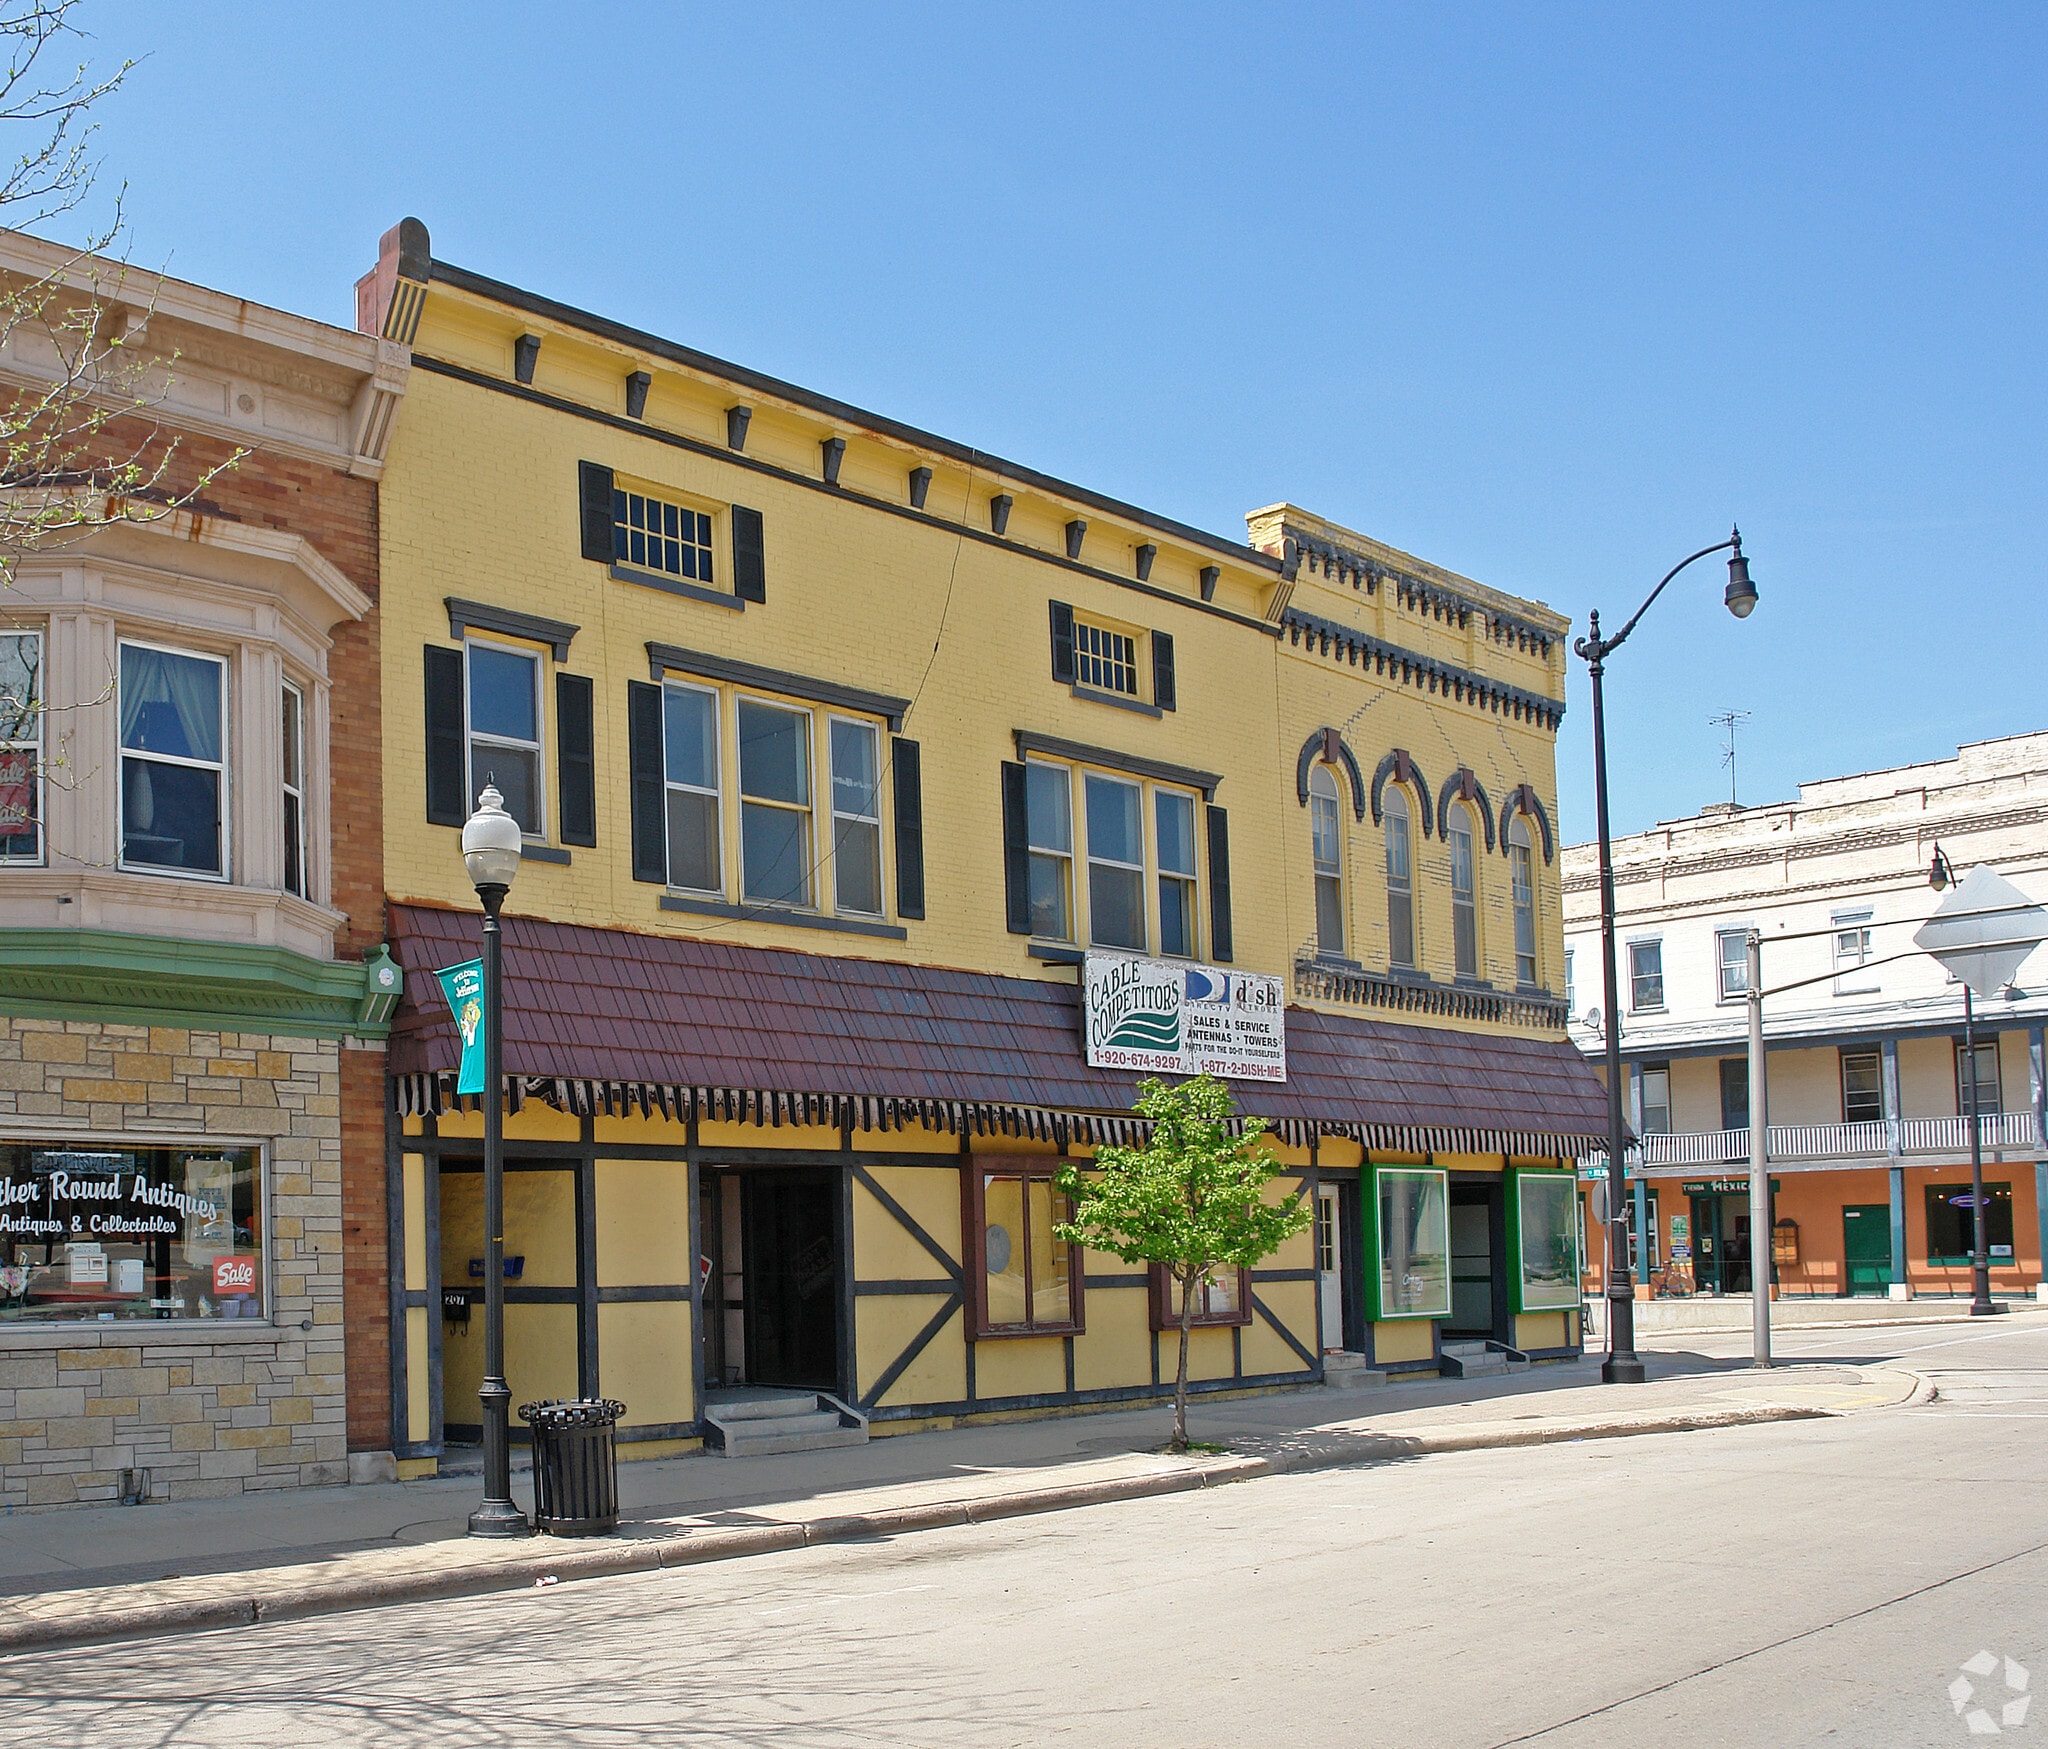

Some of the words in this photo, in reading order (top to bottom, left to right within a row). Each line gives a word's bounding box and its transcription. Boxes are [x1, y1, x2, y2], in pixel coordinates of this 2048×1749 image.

[0, 761, 27, 784] ale
[0, 801, 27, 824] ale
[1091, 960, 1141, 1013] CABLE
[1236, 980, 1276, 1006] dish
[1093, 980, 1179, 1048] COMPETITORS
[1185, 1001, 1231, 1012] DIRECTV
[1236, 1003, 1278, 1014] NETWORK
[1193, 1016, 1220, 1029] SALES
[1224, 1020, 1230, 1029] &
[1235, 1020, 1270, 1034] SERVICE
[1187, 1029, 1232, 1043] ANTENNAS
[1243, 1035, 1279, 1048] TOWERS
[1094, 1050, 1181, 1069] 1-920-674-9297
[1204, 1044, 1215, 1053] FOR
[1217, 1046, 1227, 1054] THE
[1229, 1047, 1243, 1056] DO-IT
[1200, 1059, 1281, 1078] 1-877-2-DISH-ME
[50, 1171, 122, 1200] Round
[131, 1175, 216, 1220] Antiques
[0, 1213, 63, 1236] Antiques
[71, 1215, 82, 1232] &
[90, 1214, 177, 1234] Collectables
[217, 1262, 253, 1287] Sale
[445, 1295, 464, 1305] 207
